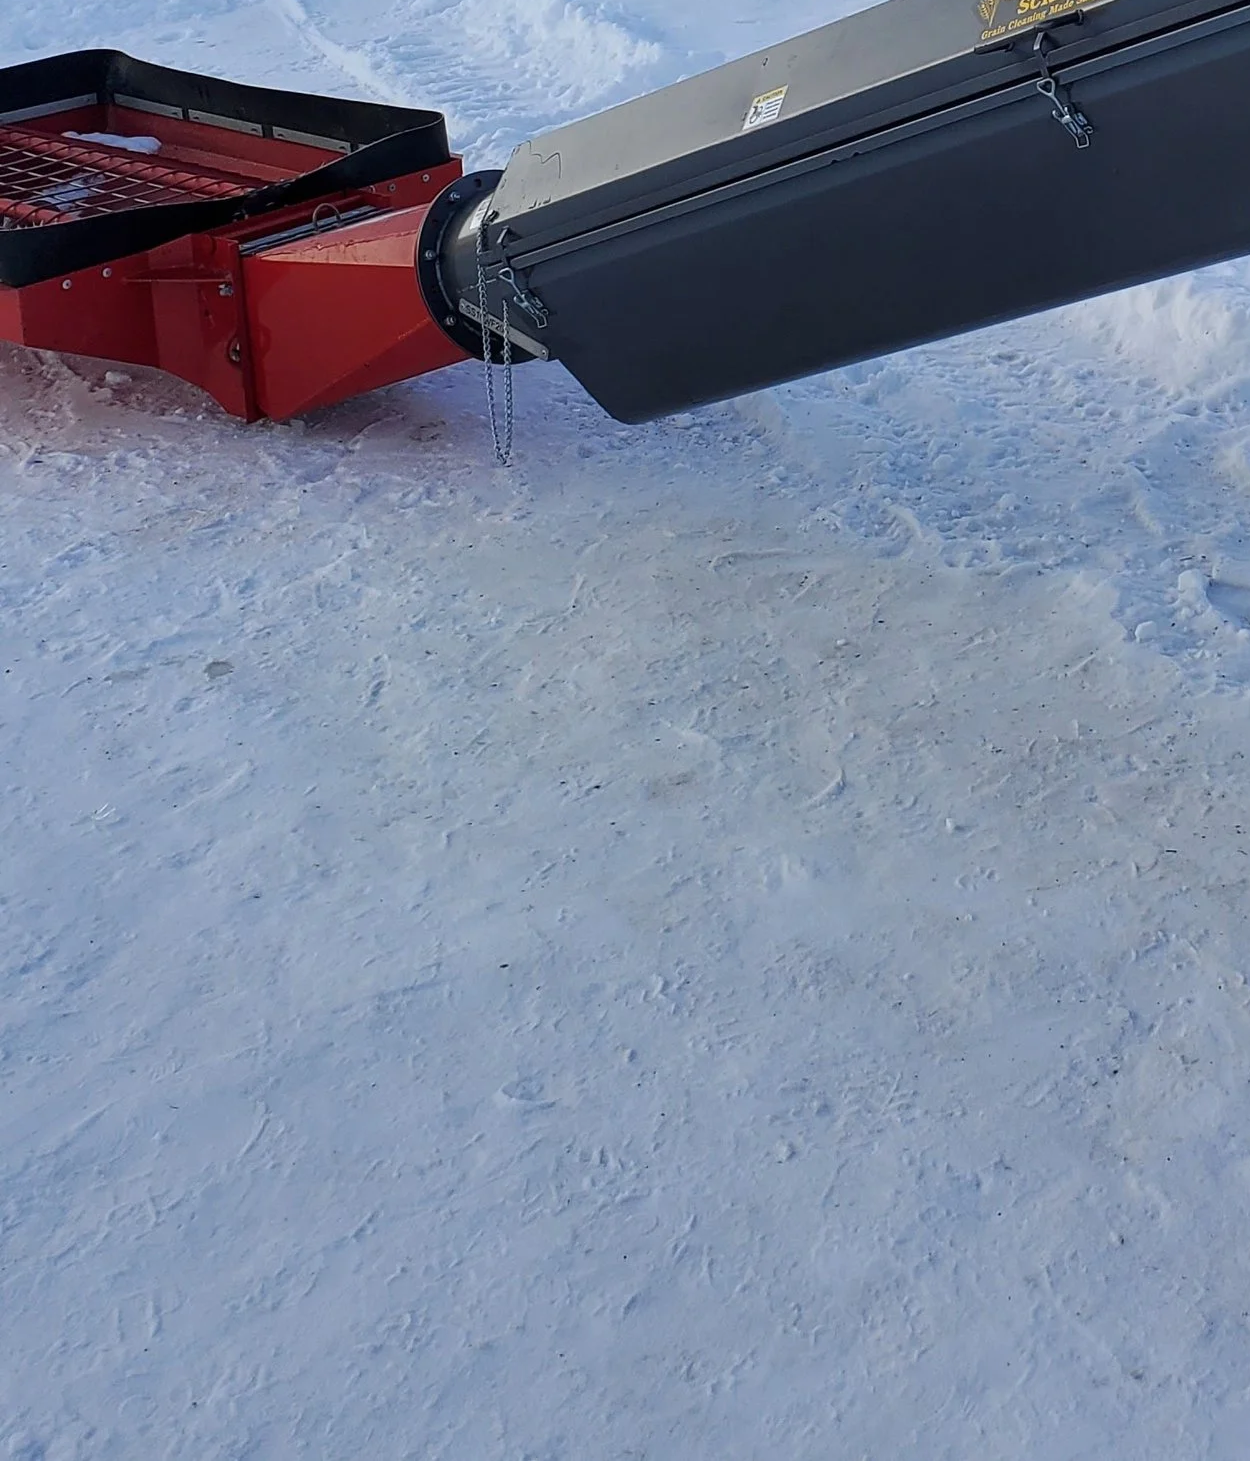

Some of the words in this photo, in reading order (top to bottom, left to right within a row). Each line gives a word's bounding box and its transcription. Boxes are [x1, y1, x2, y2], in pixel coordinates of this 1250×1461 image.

[981, 26, 1006, 40] Grain
[1008, 10, 1047, 29] Cleaning
[1048, 0, 1074, 15] Made
